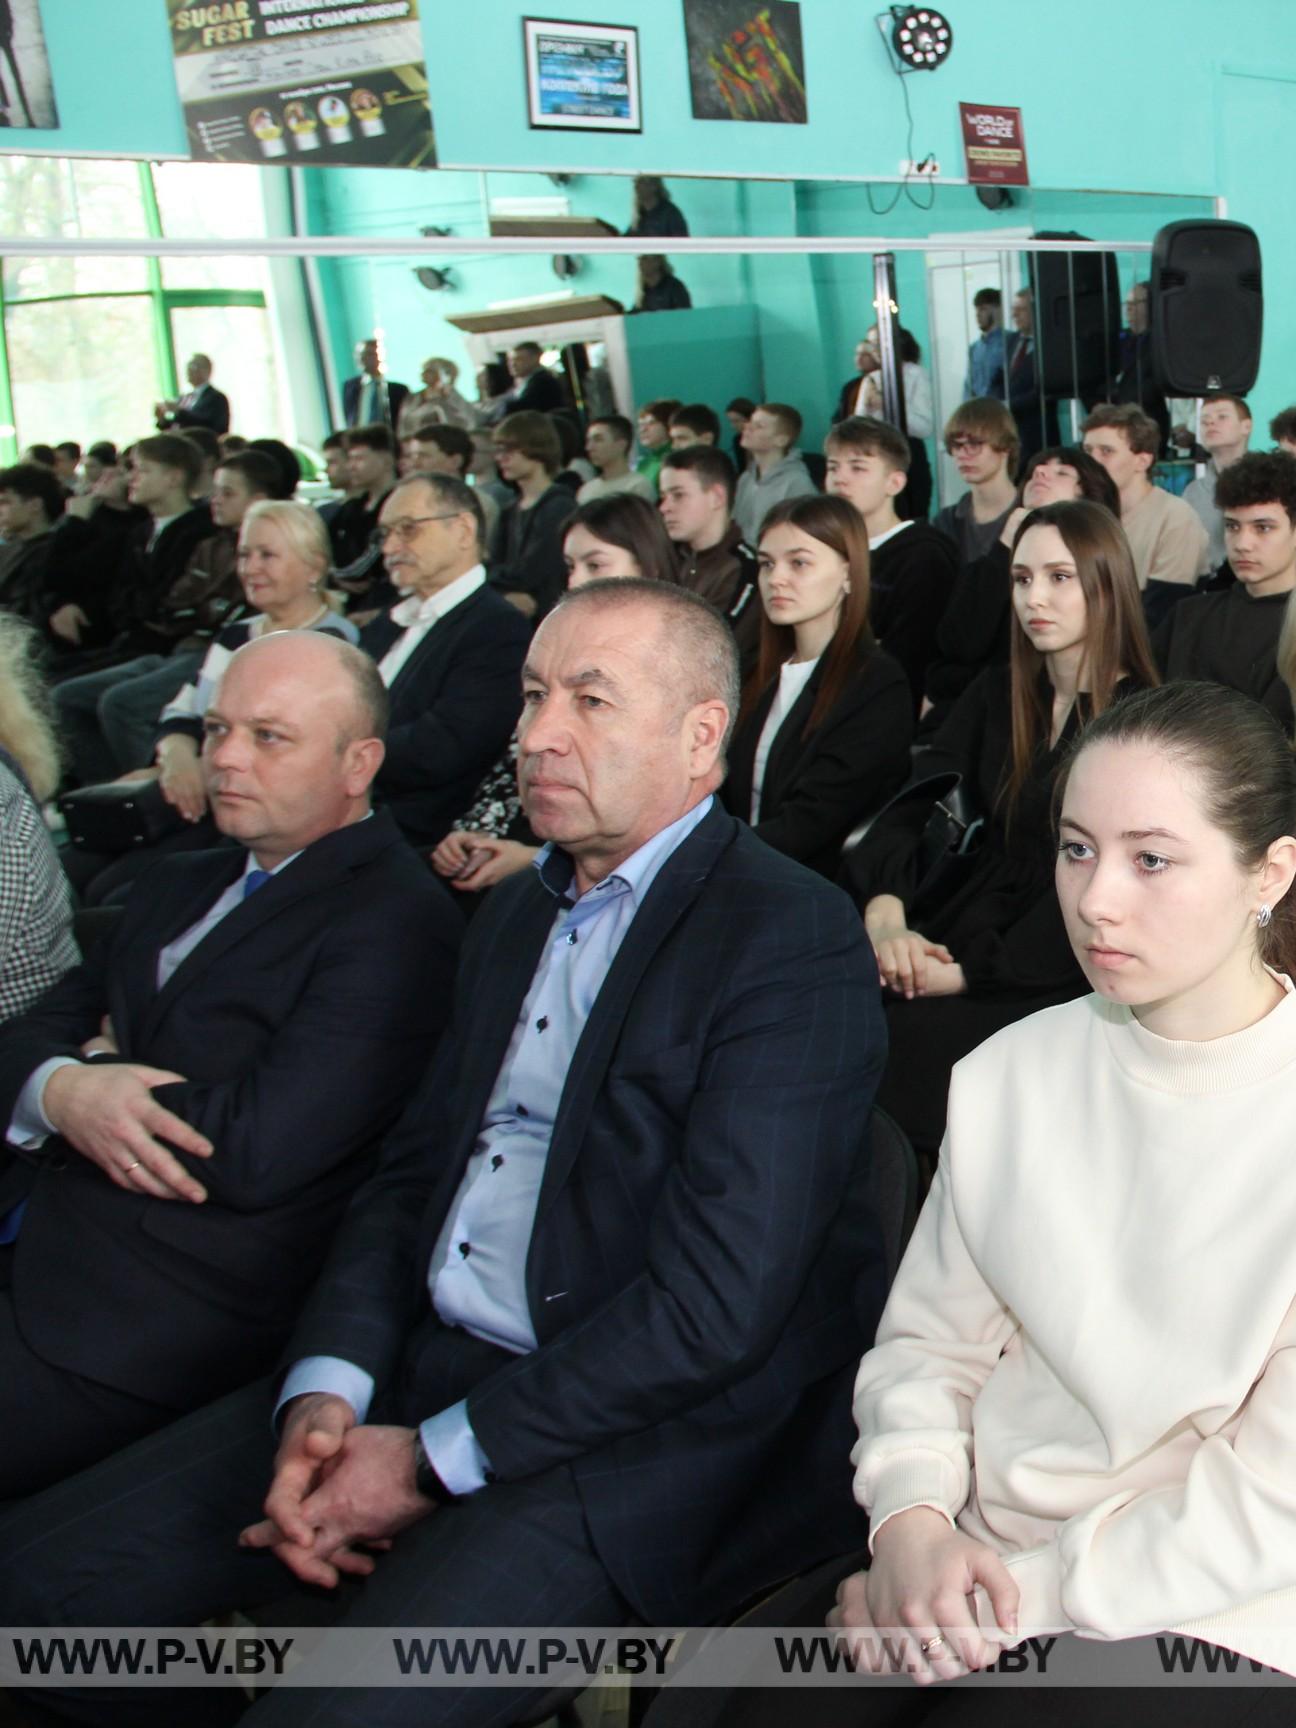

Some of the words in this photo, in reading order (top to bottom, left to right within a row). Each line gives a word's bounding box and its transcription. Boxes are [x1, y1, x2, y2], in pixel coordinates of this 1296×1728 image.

[176, 1, 250, 30] SUGAR
[265, 15, 312, 35] DANCE
[203, 19, 255, 46] FEST
[965, 113, 1005, 126] WORLD
[976, 125, 1014, 138] DANCE
